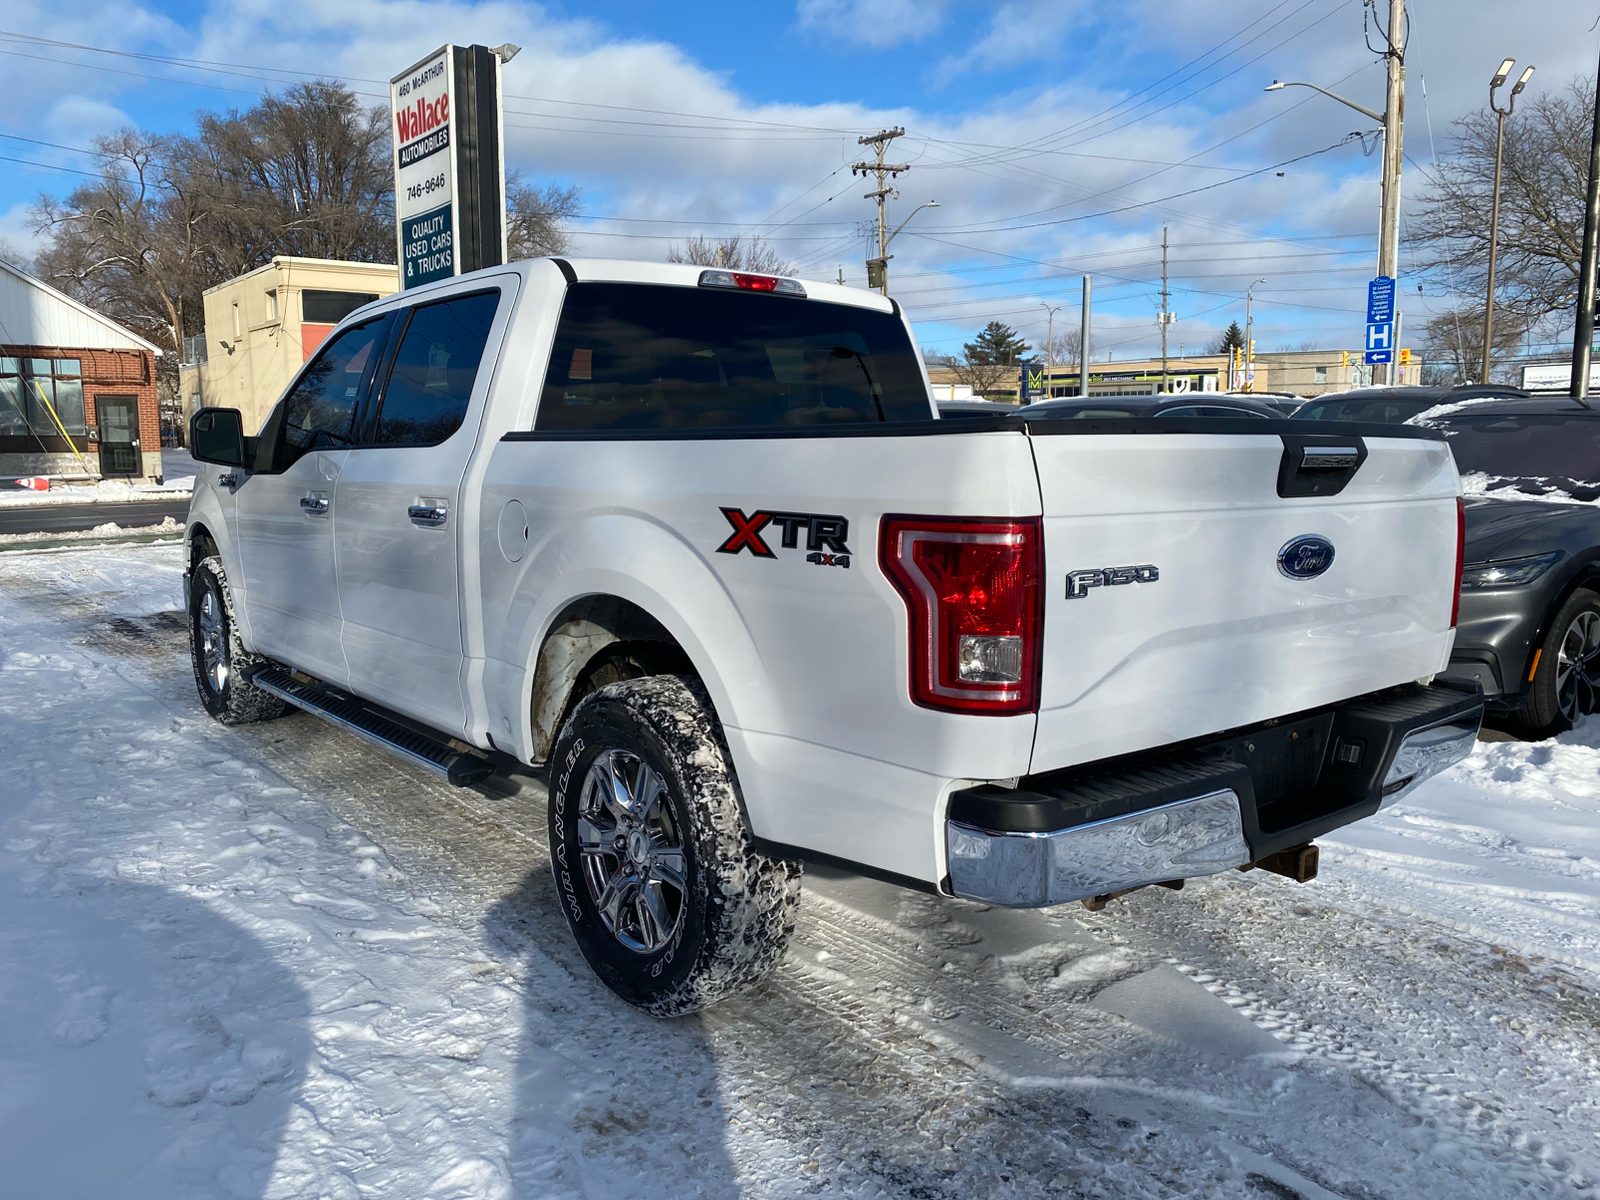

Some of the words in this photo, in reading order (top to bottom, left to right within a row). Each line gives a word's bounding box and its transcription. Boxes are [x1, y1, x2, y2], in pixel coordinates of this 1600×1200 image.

[399, 82, 410, 97] 460
[412, 61, 444, 91] McARTHUR
[396, 92, 449, 144] Wallace
[401, 129, 448, 164] AUTOMOBILES
[407, 172, 445, 201] 746-9646
[411, 214, 444, 239] QUALITY
[405, 240, 428, 259] USED
[431, 230, 452, 251] CARS
[407, 261, 414, 277] &
[417, 249, 452, 275] TRUCKS
[1369, 324, 1389, 349] H
[714, 506, 853, 560] XTR
[1293, 545, 1326, 571] Ford
[555, 737, 586, 923] WRANGLER
